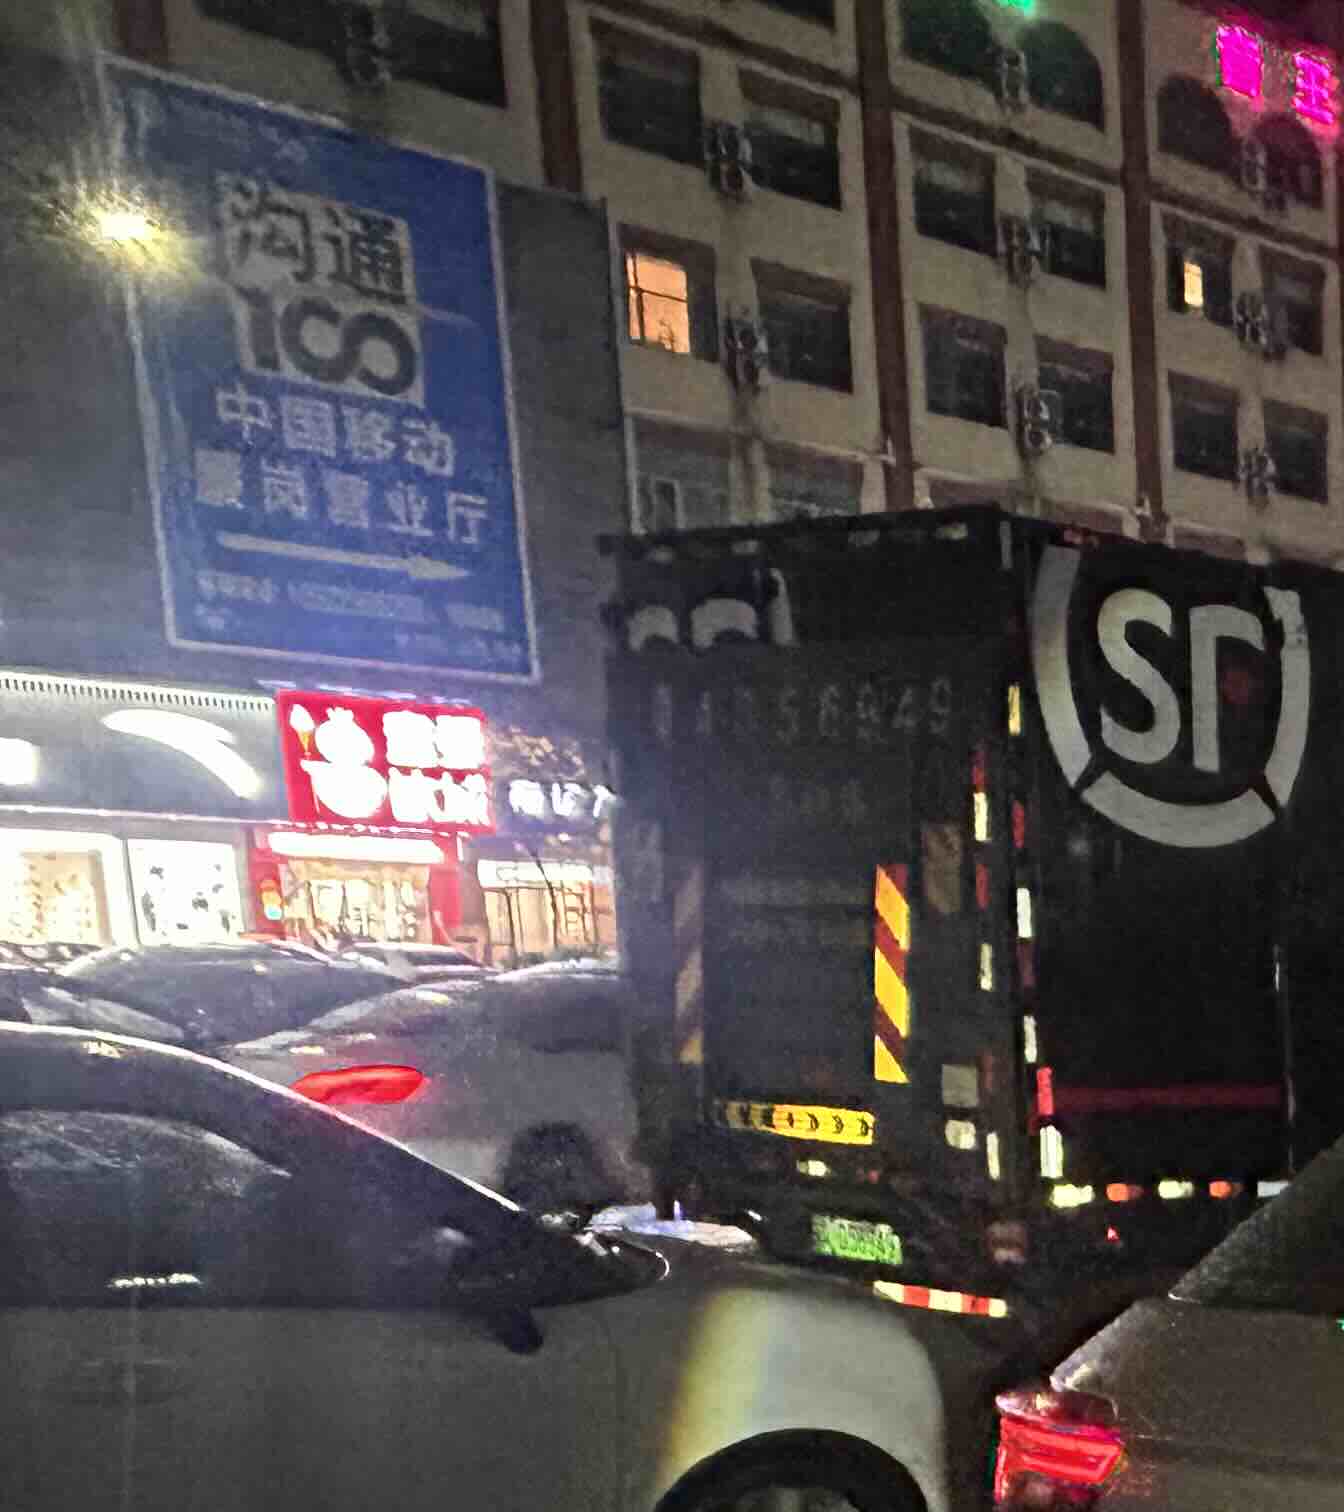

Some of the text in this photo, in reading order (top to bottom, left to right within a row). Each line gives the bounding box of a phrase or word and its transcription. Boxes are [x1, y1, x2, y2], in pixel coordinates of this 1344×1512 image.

[230, 182, 409, 305] 沟通
[240, 287, 417, 396] 100
[215, 382, 455, 480] 中国移动
